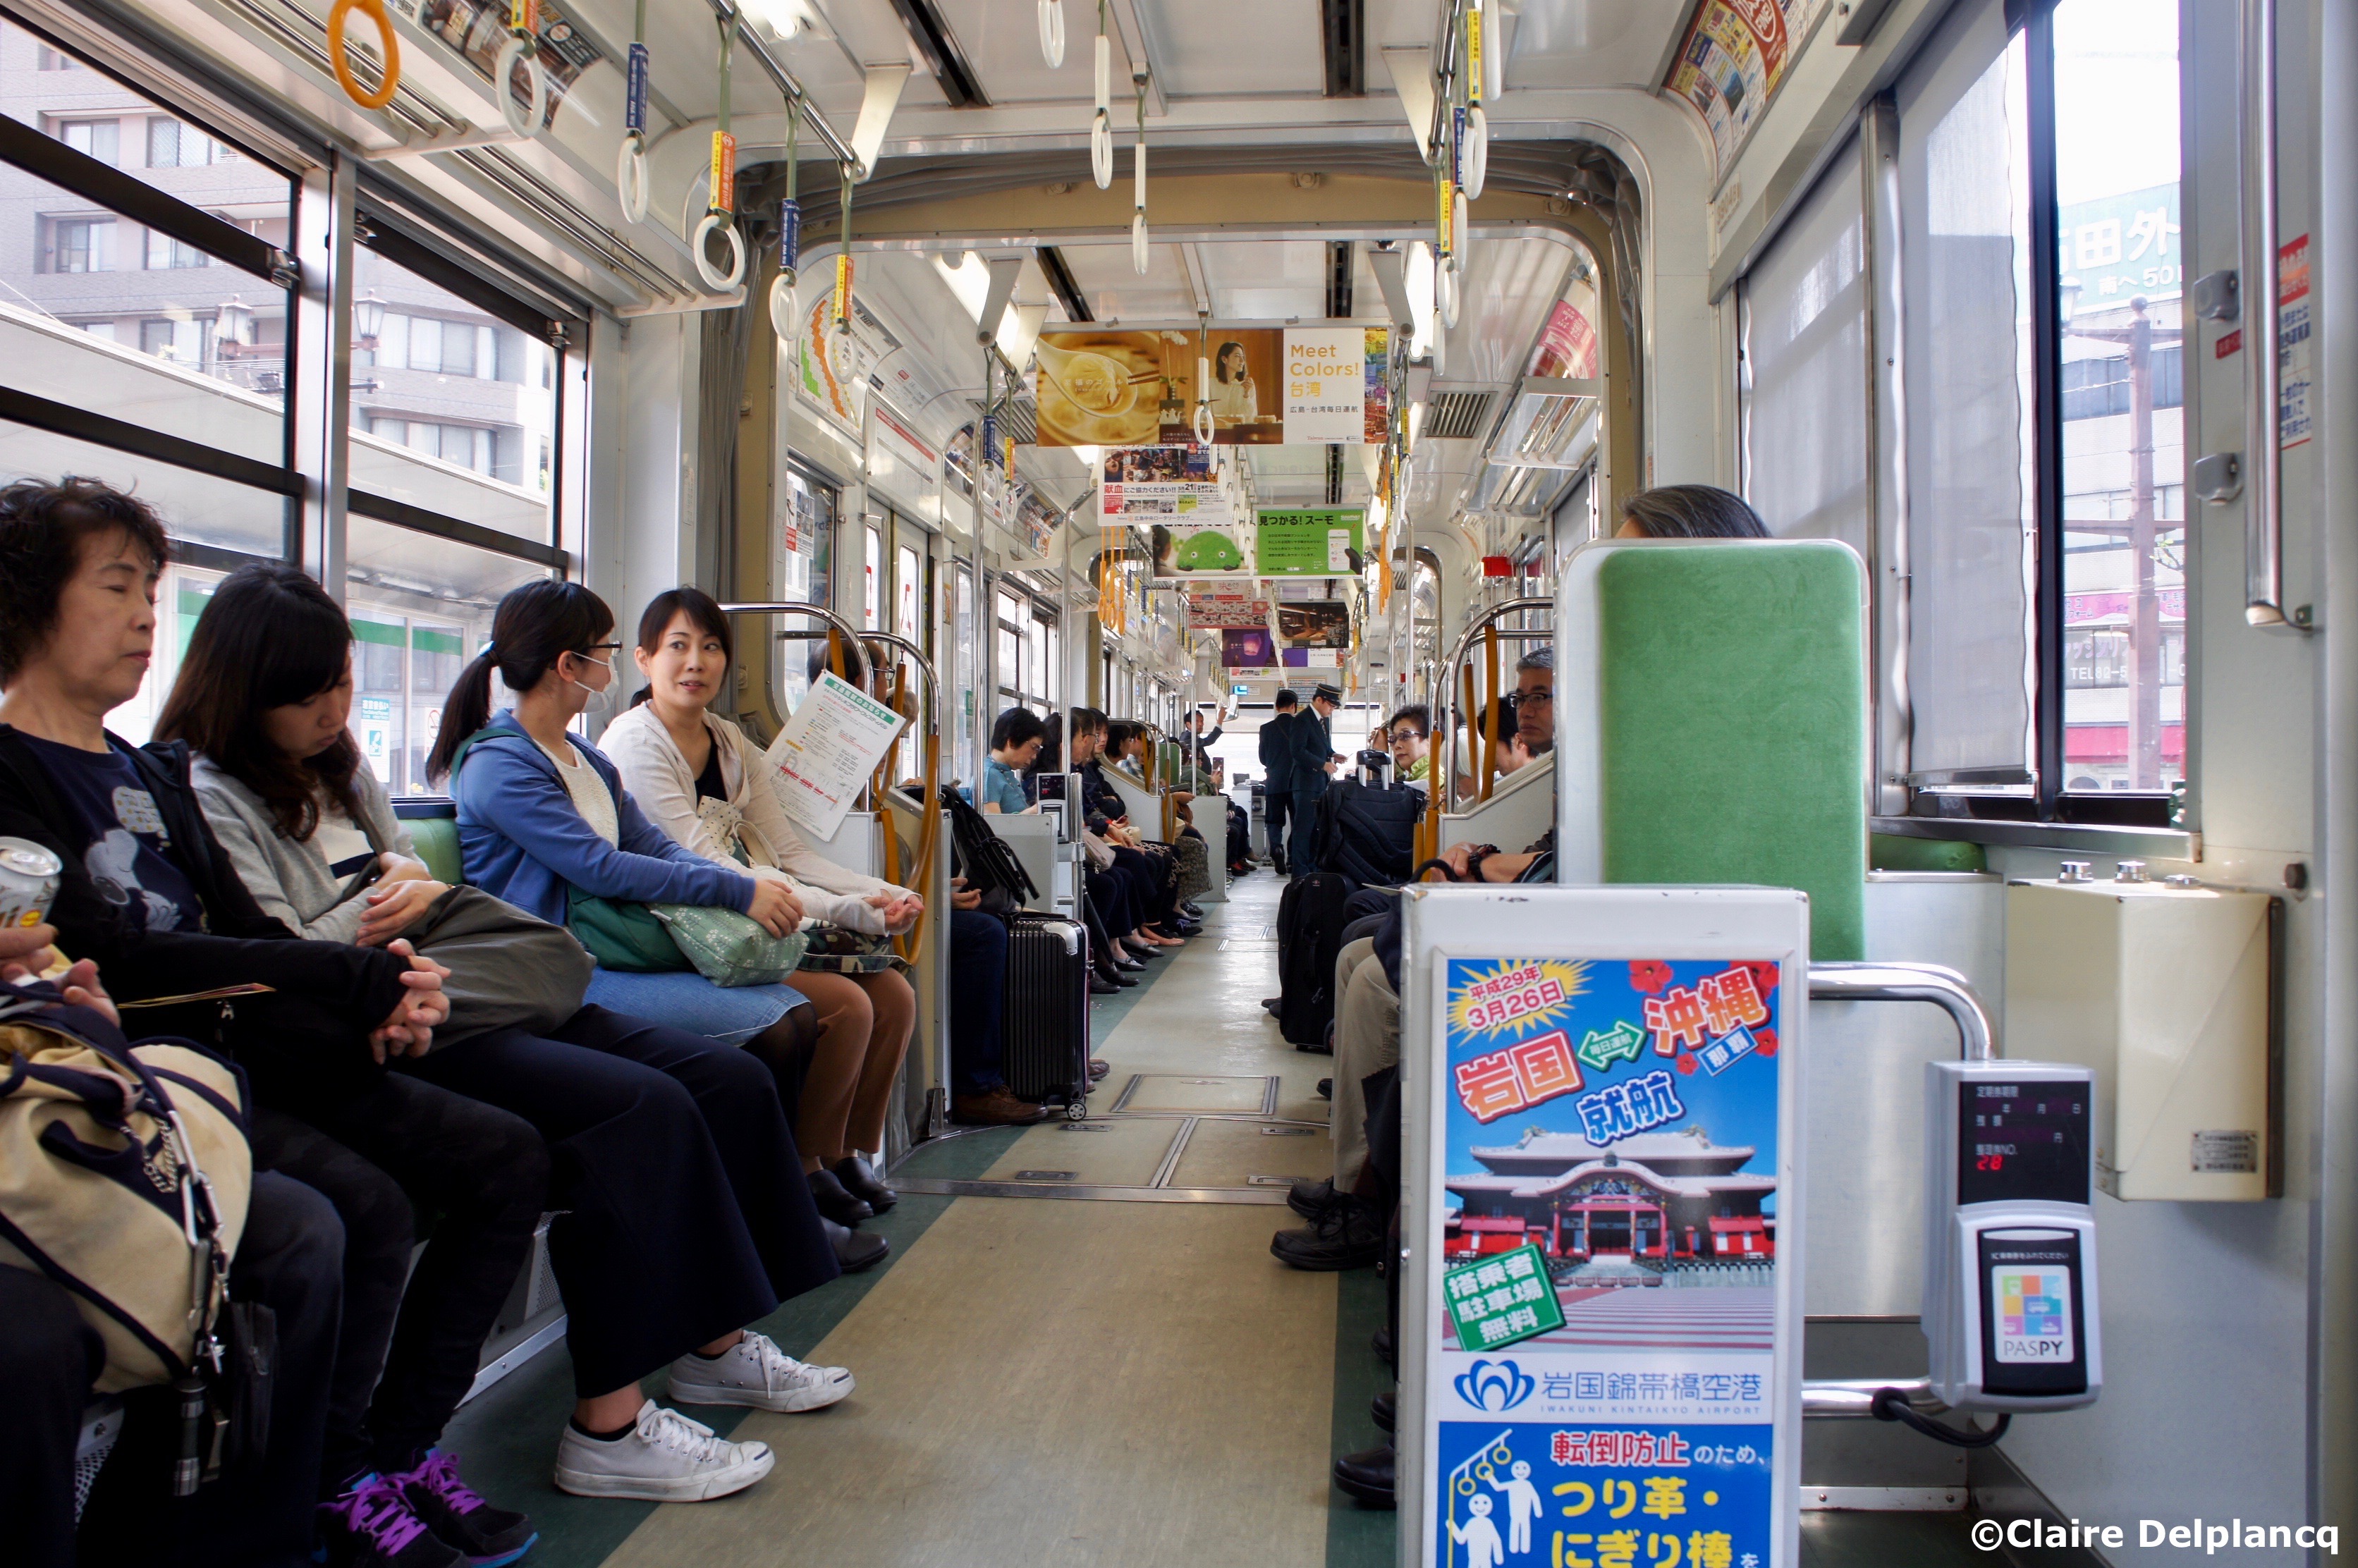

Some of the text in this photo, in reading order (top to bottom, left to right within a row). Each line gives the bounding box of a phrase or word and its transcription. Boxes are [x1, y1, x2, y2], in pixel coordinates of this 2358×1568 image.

[1290, 344, 1336, 358] Meet
[1290, 362, 1359, 376] Colors!
[1290, 381, 1321, 398] 台湾
[831, 681, 888, 721] 交通規制のお知らせ
[1469, 965, 1541, 1000] 平成29年
[1467, 979, 1563, 1029] 3月26日
[1645, 965, 1771, 1056] 沖縄
[1589, 1033, 1633, 1056] 毎日運航
[1456, 1031, 1582, 1121] 岩国
[1577, 1072, 1684, 1144] 就航
[1977, 1154, 2003, 1170] 28
[1448, 1252, 1535, 1300] 搭乗者
[1456, 1277, 1545, 1323] 駐車場
[1479, 1305, 1539, 1344] 無料
[2003, 1340, 2064, 1356] PASPY
[1541, 1371, 1761, 1402] 岩国錦帯橋空港
[1541, 1405, 1761, 1416] IWAKUNI KINTAIKYO AIRPORT
